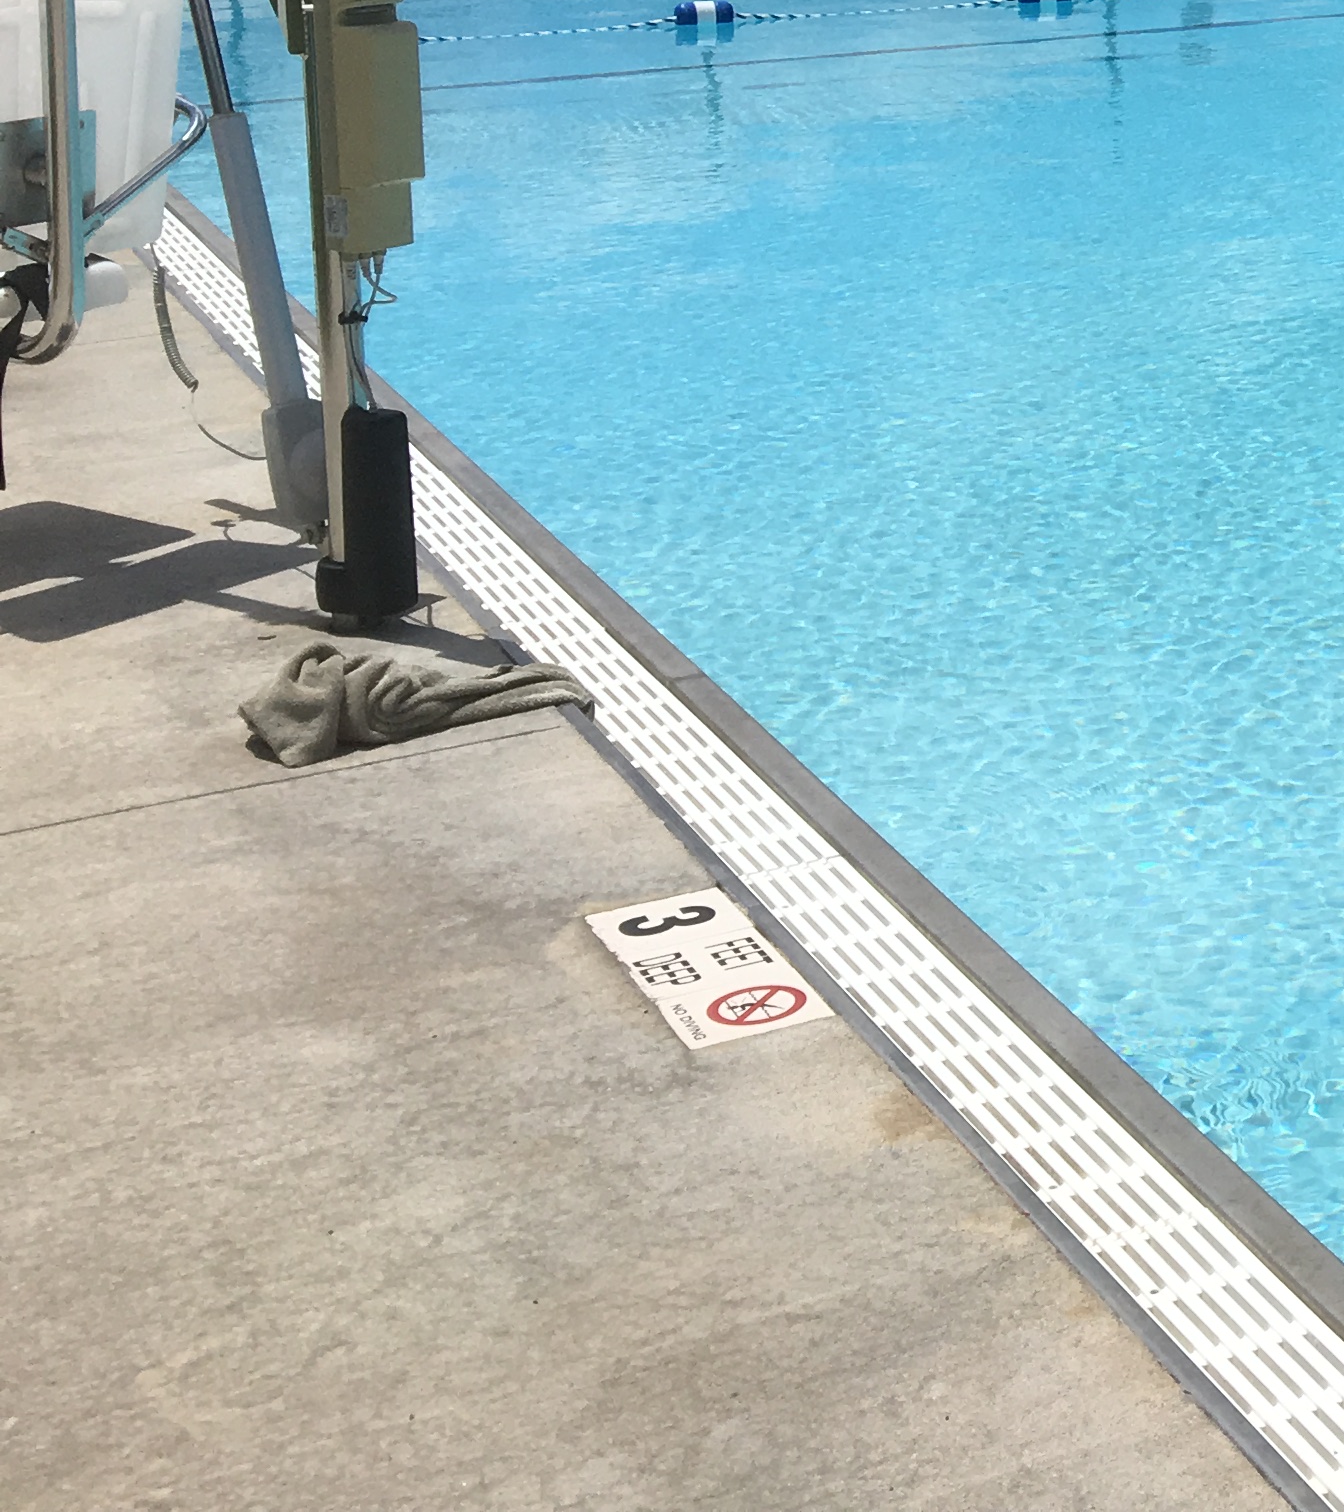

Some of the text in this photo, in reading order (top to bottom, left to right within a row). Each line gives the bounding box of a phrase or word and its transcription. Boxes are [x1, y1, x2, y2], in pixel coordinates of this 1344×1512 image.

[618, 906, 716, 936] 3
[632, 952, 702, 987] DEEP
[704, 936, 774, 971] FEET
[670, 1003, 707, 1041] NO DIVING
